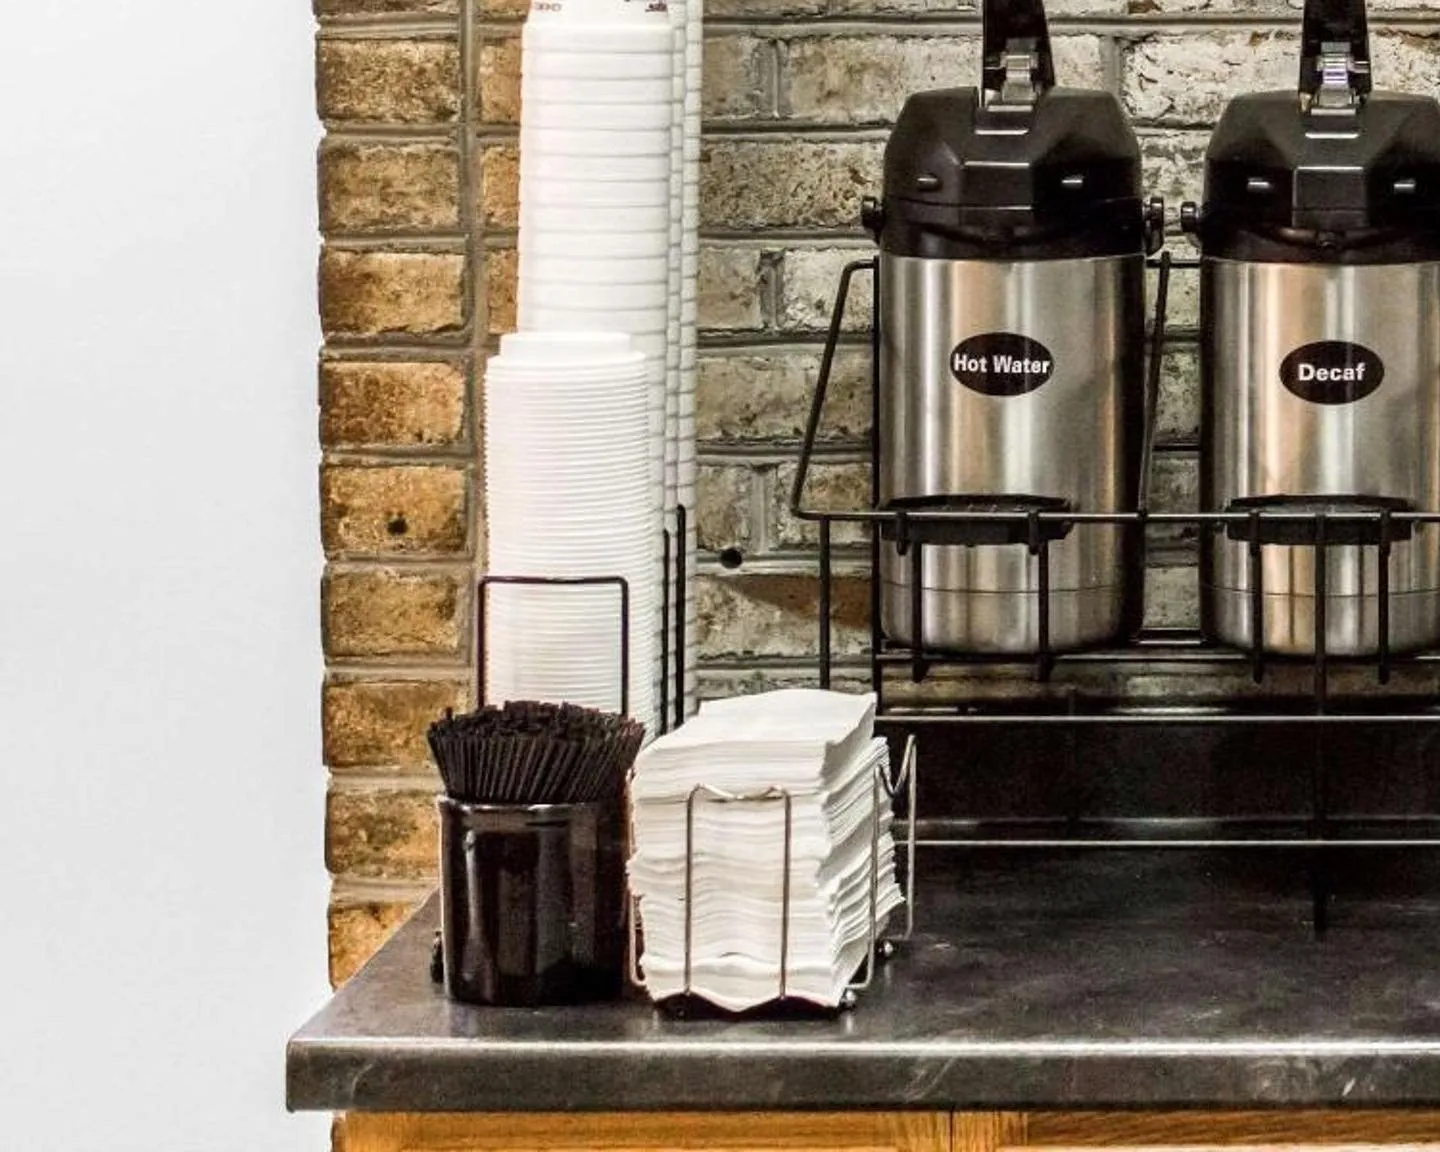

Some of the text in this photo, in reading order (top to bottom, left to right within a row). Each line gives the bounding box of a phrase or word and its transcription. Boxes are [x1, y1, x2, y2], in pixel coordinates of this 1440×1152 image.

[953, 353, 1051, 374] Hot Water
[1297, 361, 1367, 382] Decaf
